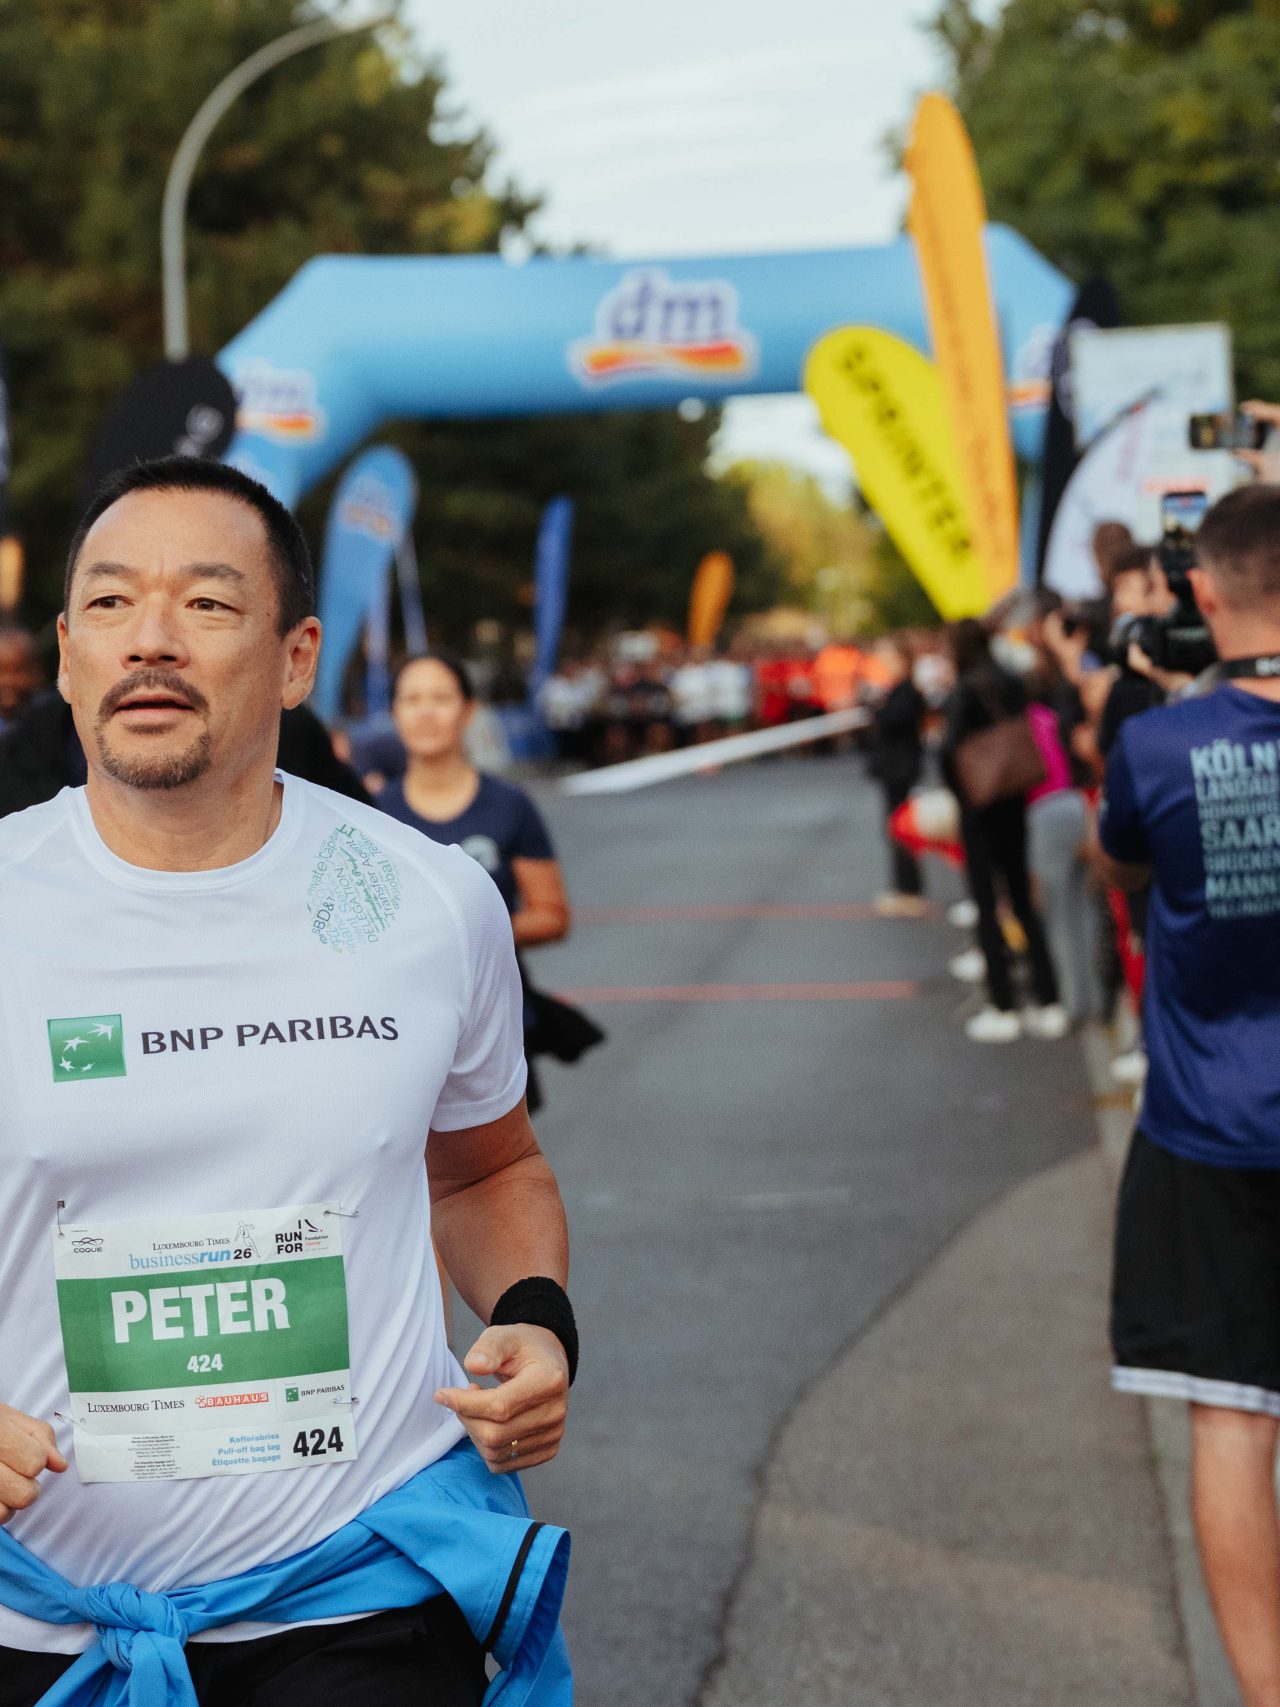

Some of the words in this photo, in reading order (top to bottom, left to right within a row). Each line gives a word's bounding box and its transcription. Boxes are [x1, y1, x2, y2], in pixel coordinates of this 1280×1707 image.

[609, 275, 723, 341] dm
[141, 1027, 224, 1055] BNP
[236, 1015, 399, 1047] PARIBAS
[275, 1231, 302, 1243] RUN
[153, 1240, 204, 1251] LUXEMBOURG
[207, 1238, 230, 1246] TIMES
[277, 1243, 303, 1254] FOR
[129, 1249, 231, 1270] businessrun
[233, 1248, 252, 1260] 26
[110, 1277, 290, 1344] PETER
[187, 1353, 223, 1373] 424
[317, 1385, 345, 1394] PARIBAS
[88, 1402, 149, 1413] LUXEMBOURG
[152, 1400, 185, 1410] TIMES
[206, 1393, 269, 1407] BAUHAUS
[293, 1426, 344, 1457] 424
[252, 1454, 281, 1462] bagage
